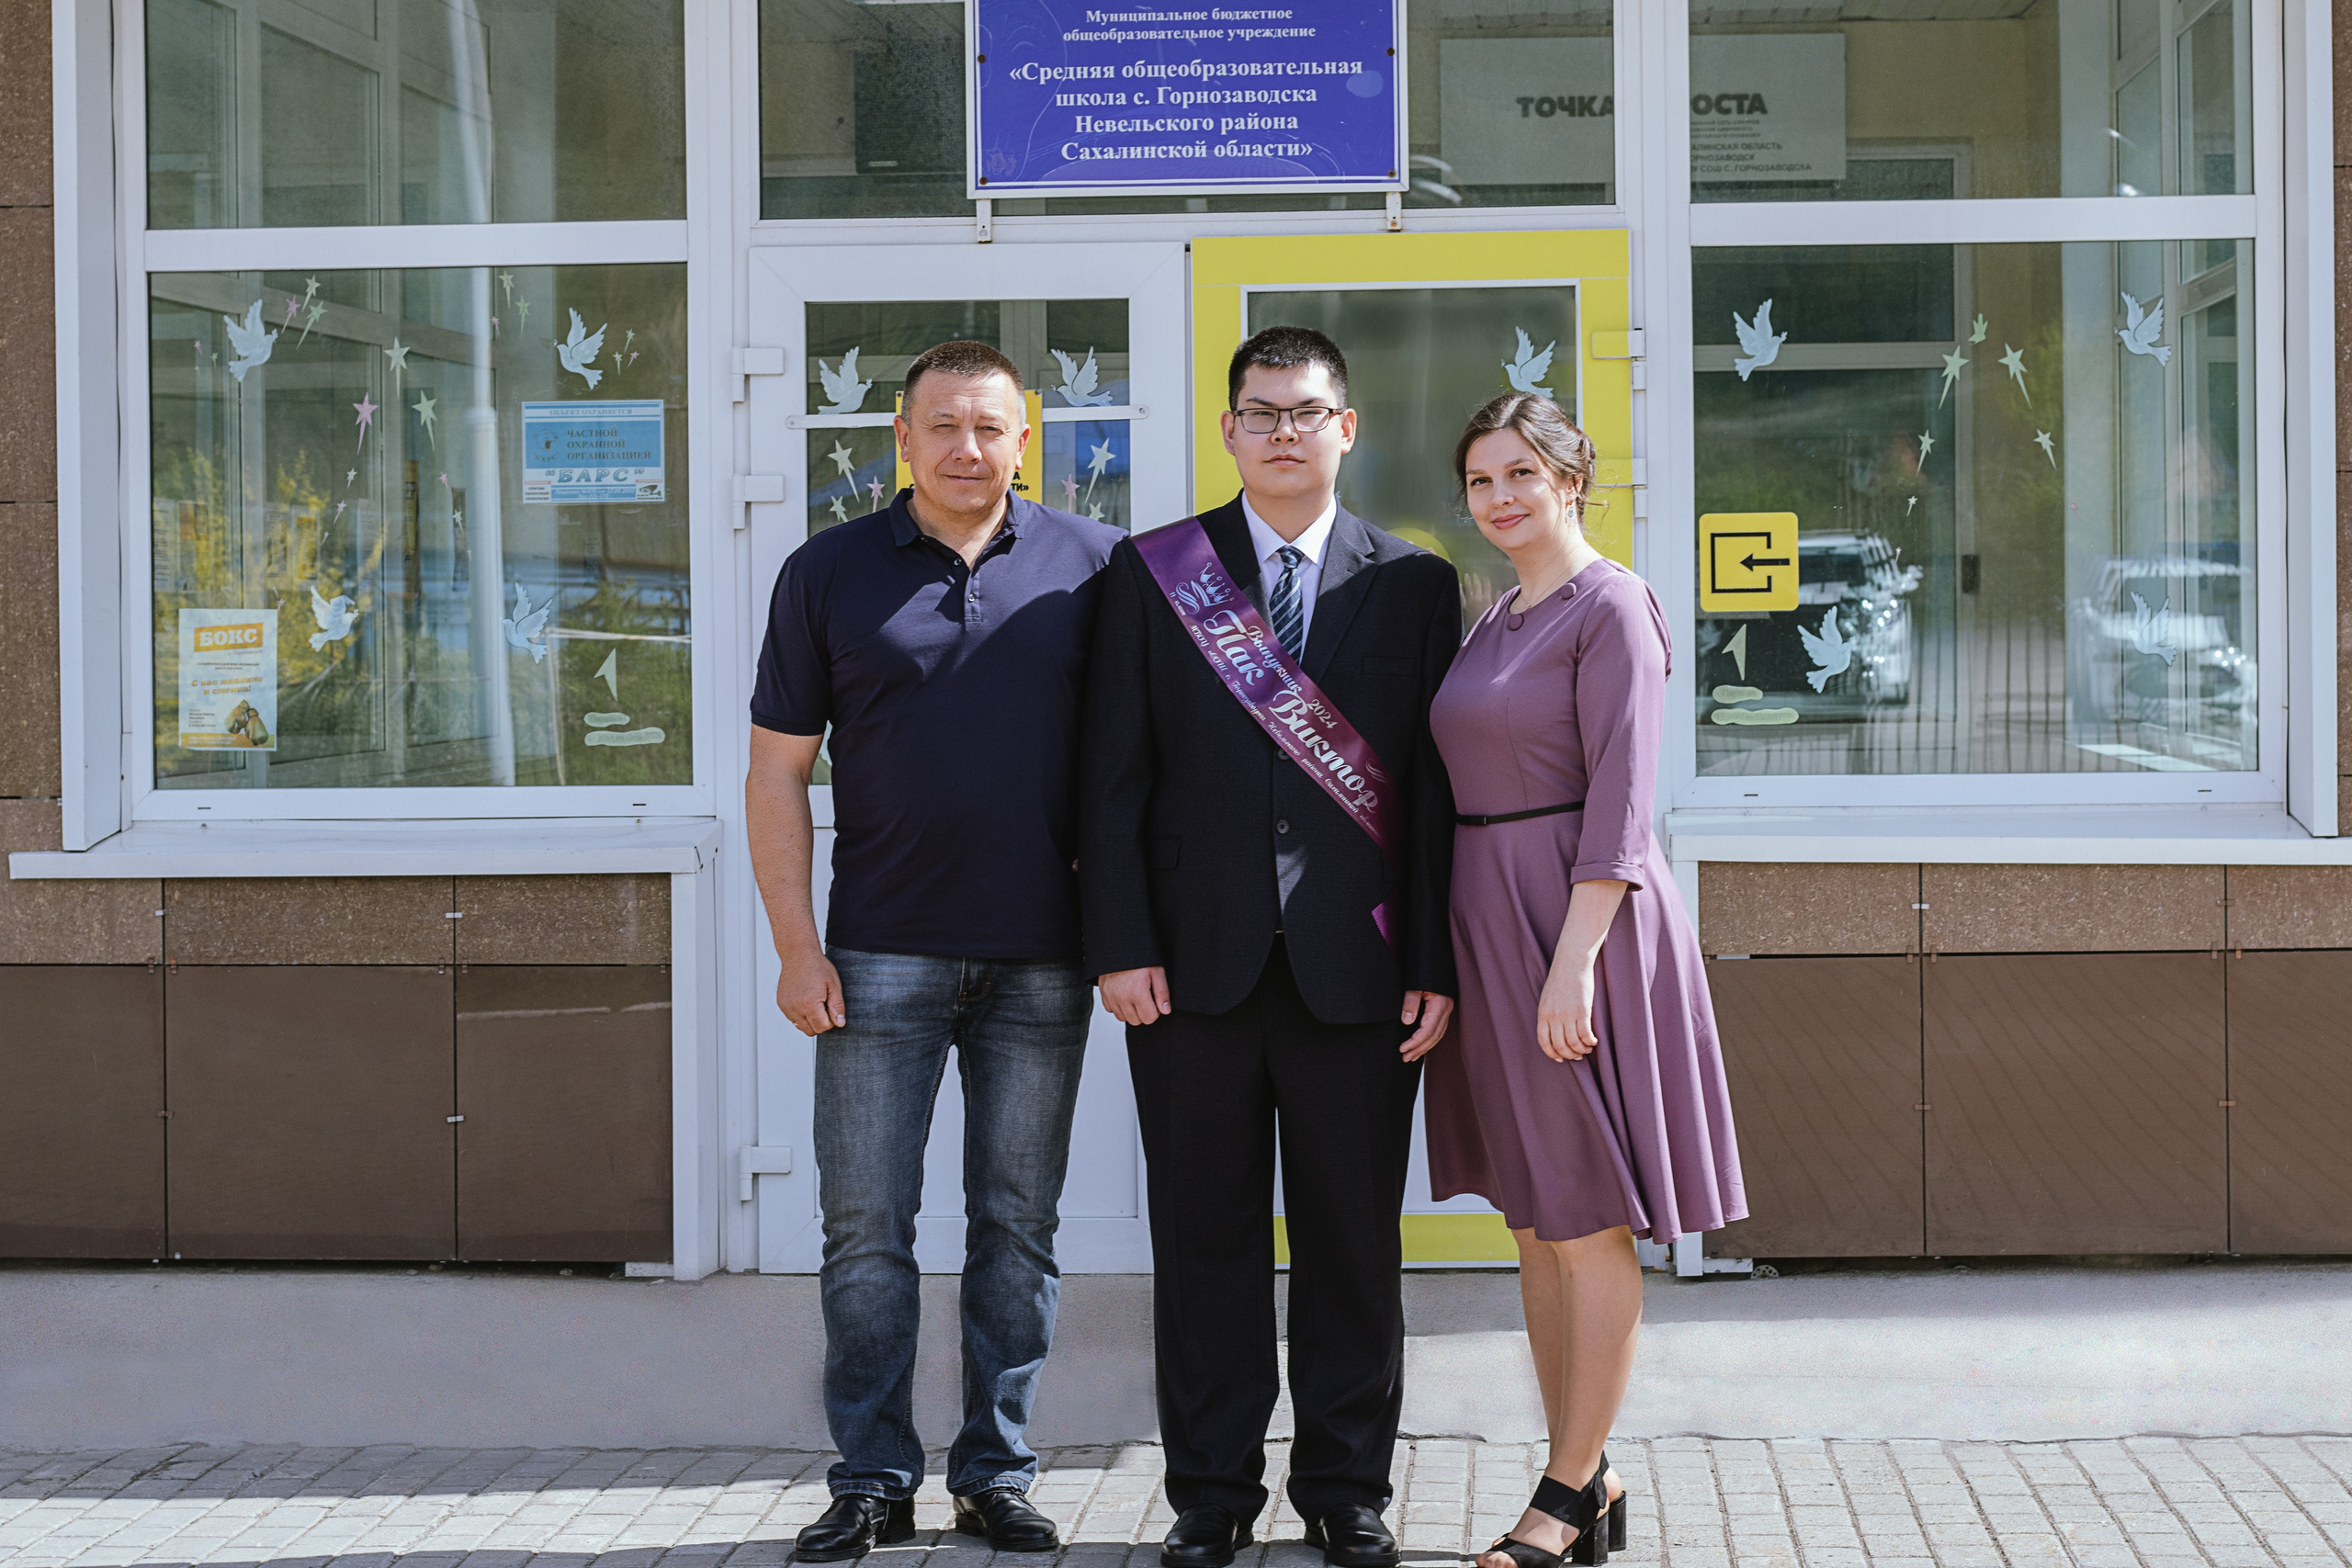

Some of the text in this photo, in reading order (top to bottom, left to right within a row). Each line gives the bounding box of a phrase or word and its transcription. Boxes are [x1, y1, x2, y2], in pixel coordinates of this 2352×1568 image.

[1086, 7, 1293, 24] Муниципальное бюджетное
[1063, 25, 1317, 42] общеобразовательное учреждение
[1010, 59, 1363, 84] «Средняя общеобразовательная
[1056, 86, 1317, 107] школа с. Горнозаводска
[1516, 93, 1768, 118] ТОЧКА ОСТА
[1075, 113, 1298, 135] Невельского района
[1061, 140, 1313, 162] Сахалинской области»
[567, 428, 617, 437] ЧАСТНОЙ
[567, 439, 626, 449] ОХРАННОЙ
[567, 450, 651, 461] ОРГАНИЗАЦИЕЙ
[199, 628, 258, 647] БОКС
[1246, 626, 1338, 728] Выпускник 2024
[1204, 610, 1378, 814] Пак Виктор
[1301, 758, 1323, 778] района
